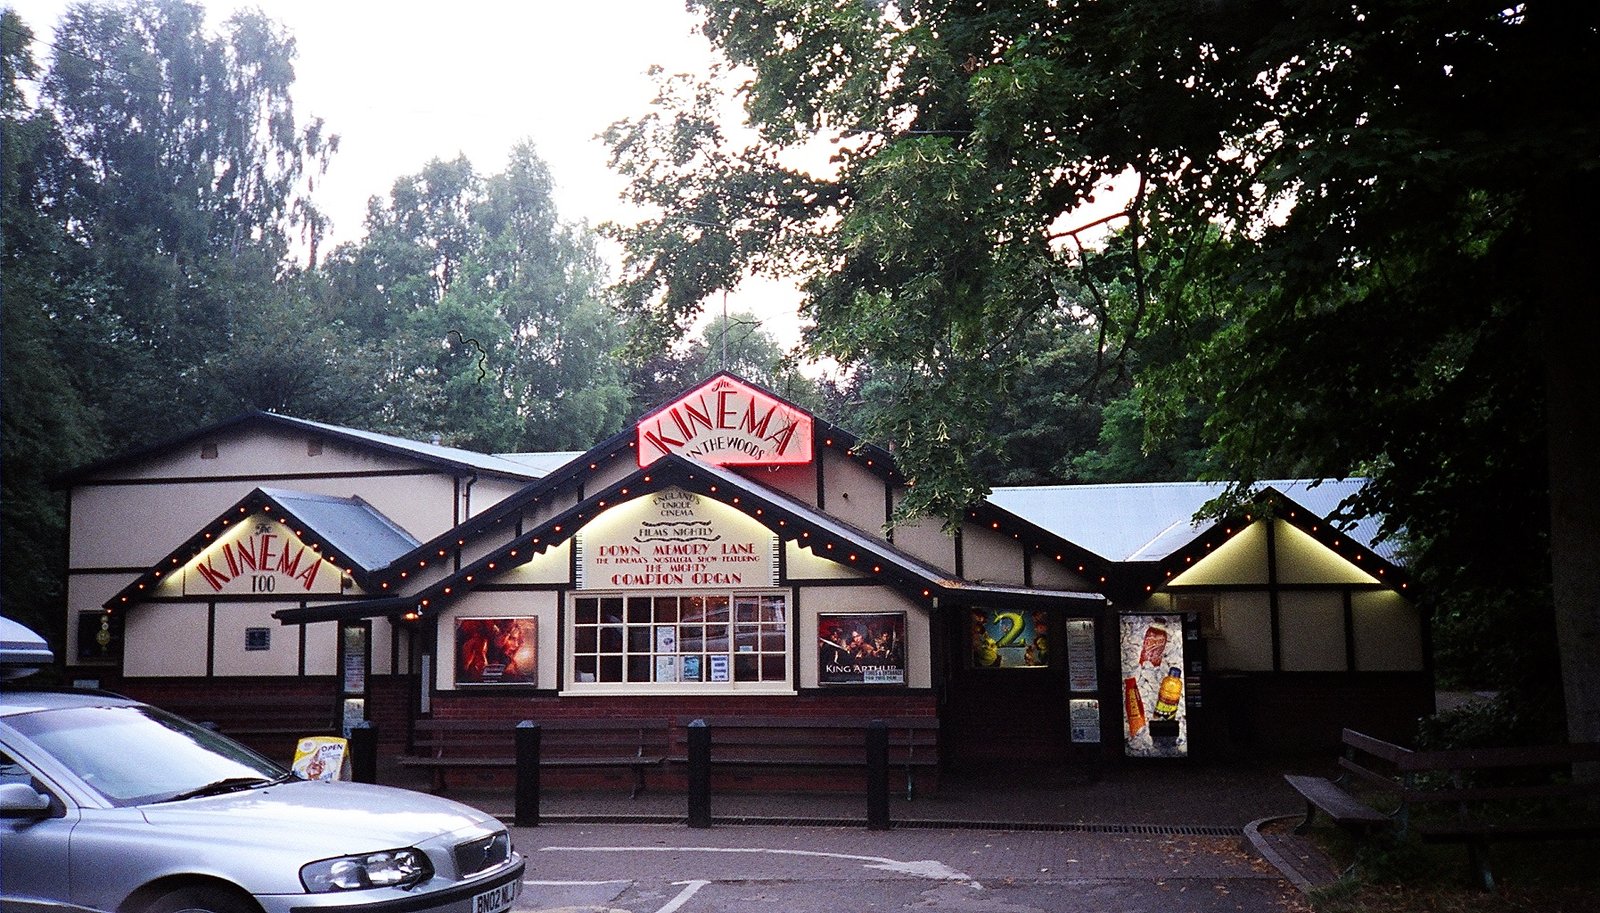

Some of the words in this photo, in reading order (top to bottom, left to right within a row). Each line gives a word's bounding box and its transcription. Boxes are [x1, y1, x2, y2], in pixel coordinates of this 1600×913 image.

[711, 380, 733, 392] The
[643, 390, 800, 457] KINEMA
[700, 436, 726, 454] THE
[726, 436, 765, 460] WOODS
[662, 501, 692, 509] UNIQUE
[660, 509, 694, 517] CINEMA
[255, 523, 273, 536] The
[639, 528, 669, 537] FILMS
[673, 527, 714, 536] NIGHTLY
[600, 545, 641, 556] DOWN
[653, 544, 710, 556] MEMORY
[721, 543, 755, 555] LANE
[196, 534, 323, 592] KINEMA
[653, 556, 693, 564] NOSTALGIA
[722, 555, 760, 563] FEATURING
[646, 564, 661, 573] THE
[670, 563, 707, 573] MIGHTY
[251, 575, 276, 592] TOO
[611, 573, 683, 586] COMPTON
[691, 572, 742, 585] ORGAN
[826, 664, 851, 673] KING
[321, 744, 344, 753] OPEN
